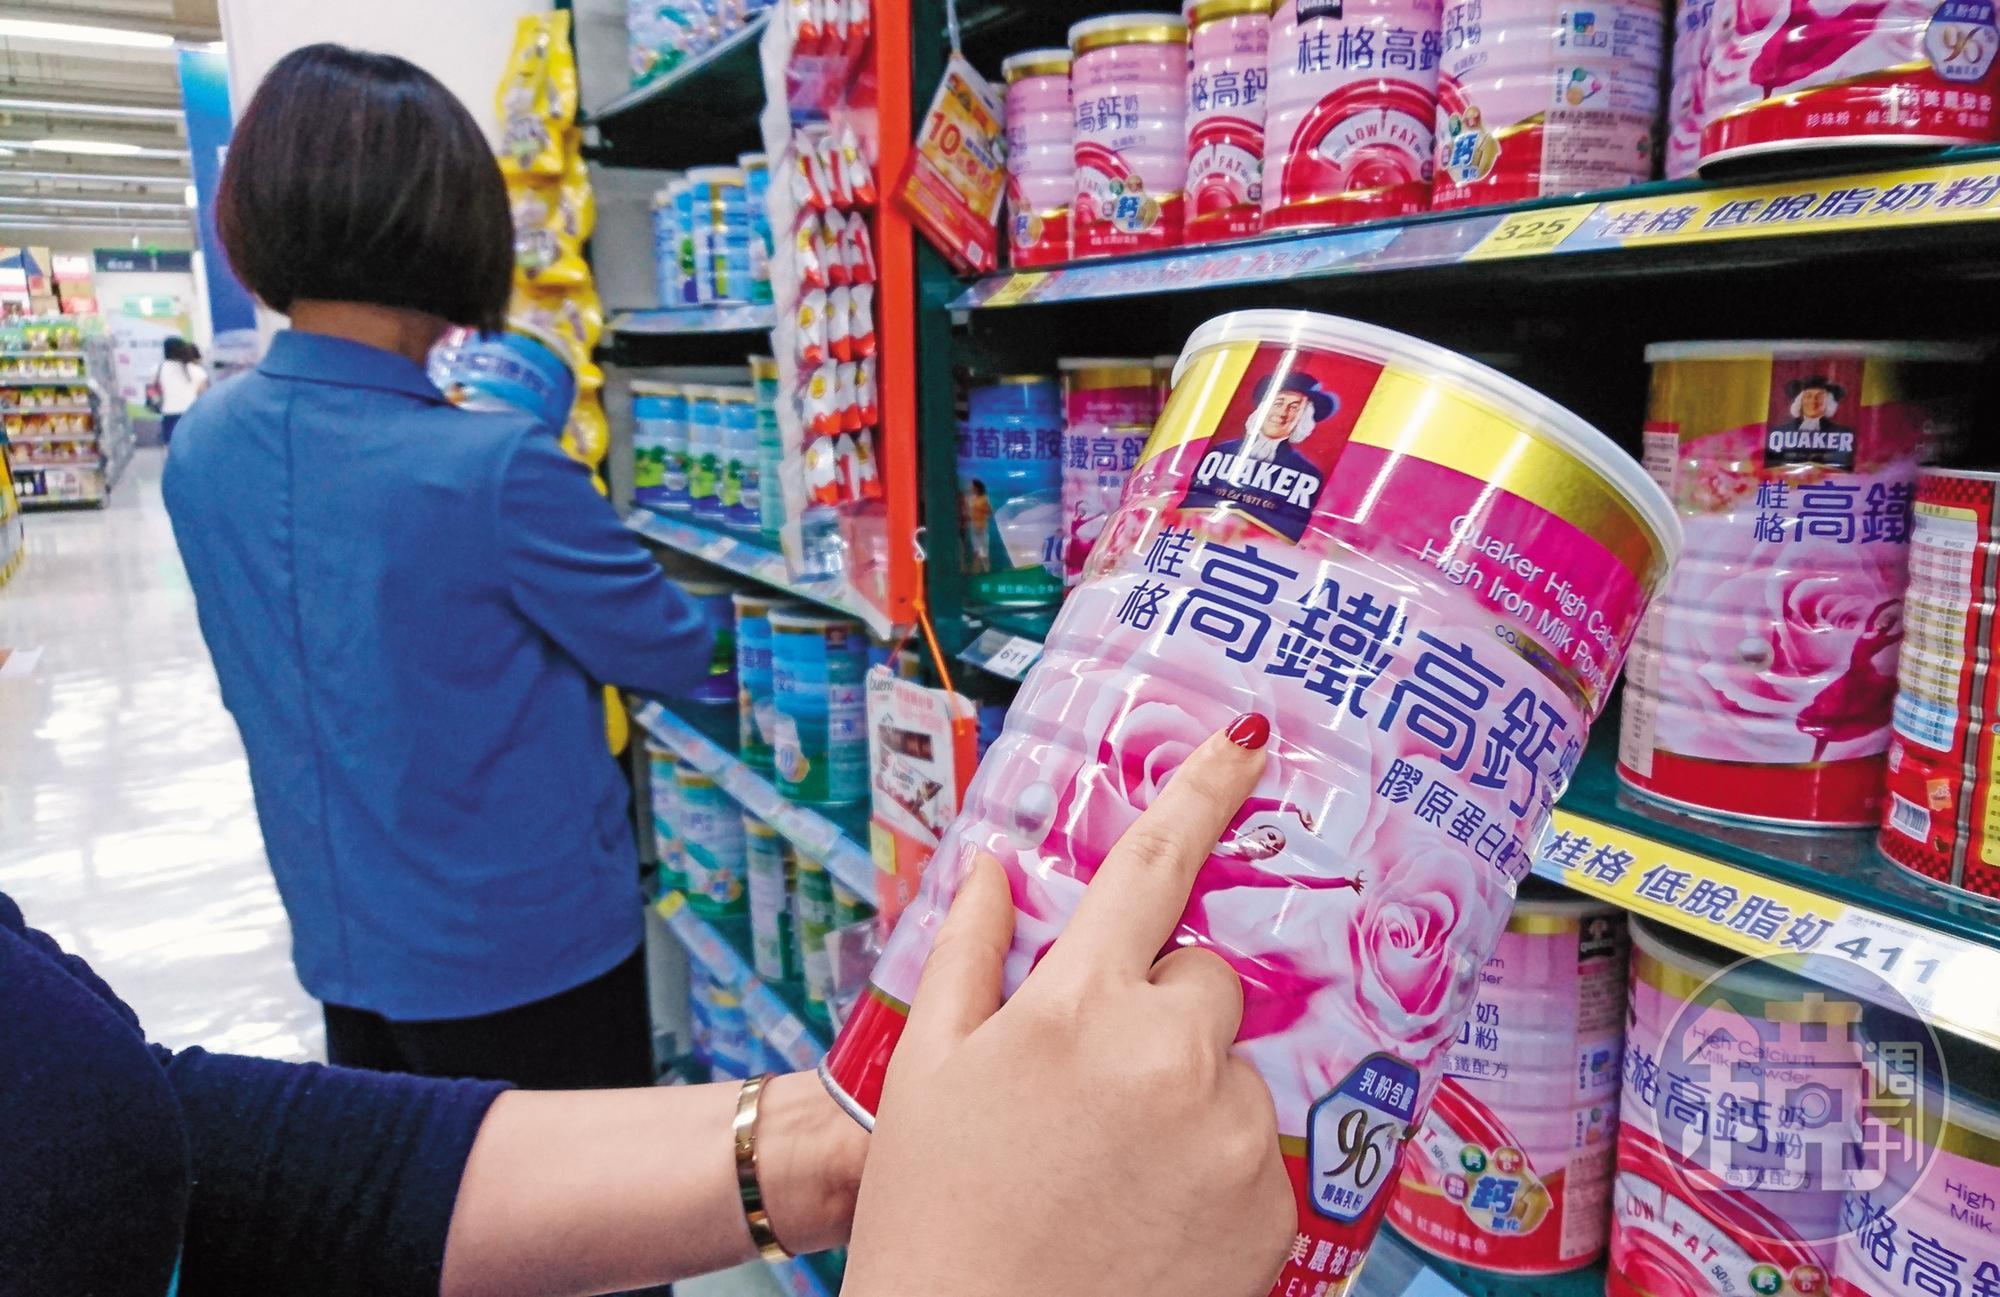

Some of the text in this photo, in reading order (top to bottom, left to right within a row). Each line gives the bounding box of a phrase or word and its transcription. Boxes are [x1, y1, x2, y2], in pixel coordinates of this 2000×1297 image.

[1345, 124, 1417, 146] LOW FAT
[1494, 218, 1572, 241] 325
[1768, 431, 1854, 452] QUAKER
[1196, 451, 1321, 509] QUAKER
[1754, 480, 1790, 545] 桂格
[1116, 525, 1196, 631] 桂格
[1450, 515, 1544, 583] Quaker
[1544, 571, 1588, 622] High
[1419, 538, 1484, 592] High
[1487, 576, 1535, 624] Iron
[1536, 609, 1575, 655] Milk
[1000, 648, 1028, 665] 611
[1542, 830, 1635, 885] 桂格
[1834, 936, 1942, 985] 411
[1474, 1001, 1500, 1052] 奶粉
[1358, 1067, 1415, 1112] 乳粉含量
[1737, 1060, 1814, 1083] Powder
[1322, 1108, 1396, 1188] 96
[1944, 1178, 1996, 1211] High
[1950, 1202, 1994, 1233] Milk
[1626, 1195, 1719, 1264] LOW FAT
